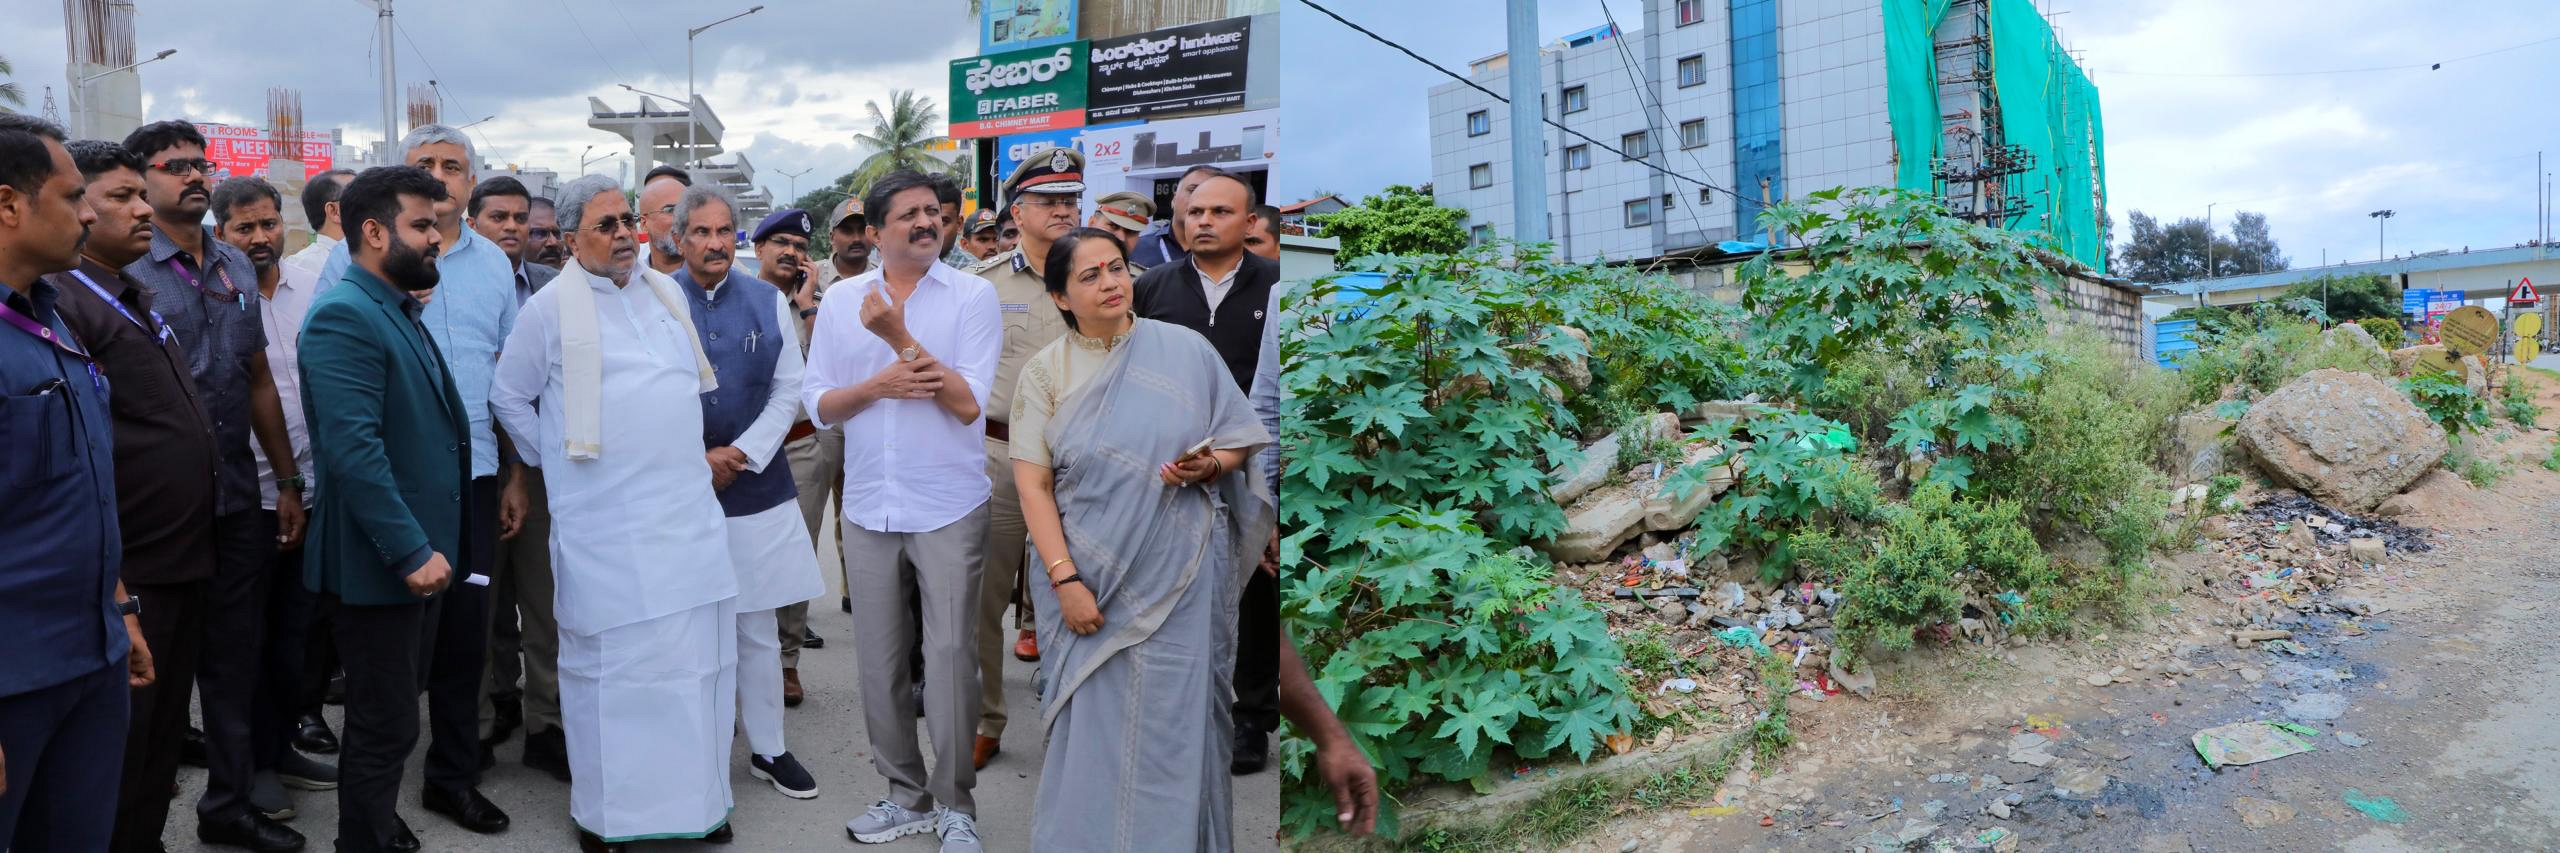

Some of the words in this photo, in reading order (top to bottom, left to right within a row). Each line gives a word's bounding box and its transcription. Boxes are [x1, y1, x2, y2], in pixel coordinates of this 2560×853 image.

[1180, 31, 1242, 50] hindware
[1182, 49, 1201, 58] smart
[1202, 45, 1239, 56] appliances
[966, 47, 1072, 95] ಫೇಬರ್
[1101, 85, 1123, 94] Chimneys
[1164, 85, 1182, 93] Kitchen
[1182, 83, 1196, 91] Sinks
[993, 92, 1059, 112] FABER
[1204, 96, 1226, 105] CHIMNEY
[1226, 94, 1241, 102] MART
[995, 117, 1027, 129] CHIMNEY
[1029, 115, 1051, 125] MART
[218, 126, 257, 137] ROOMS
[1094, 140, 1121, 158] 2x2
[1156, 183, 1170, 195] BG
